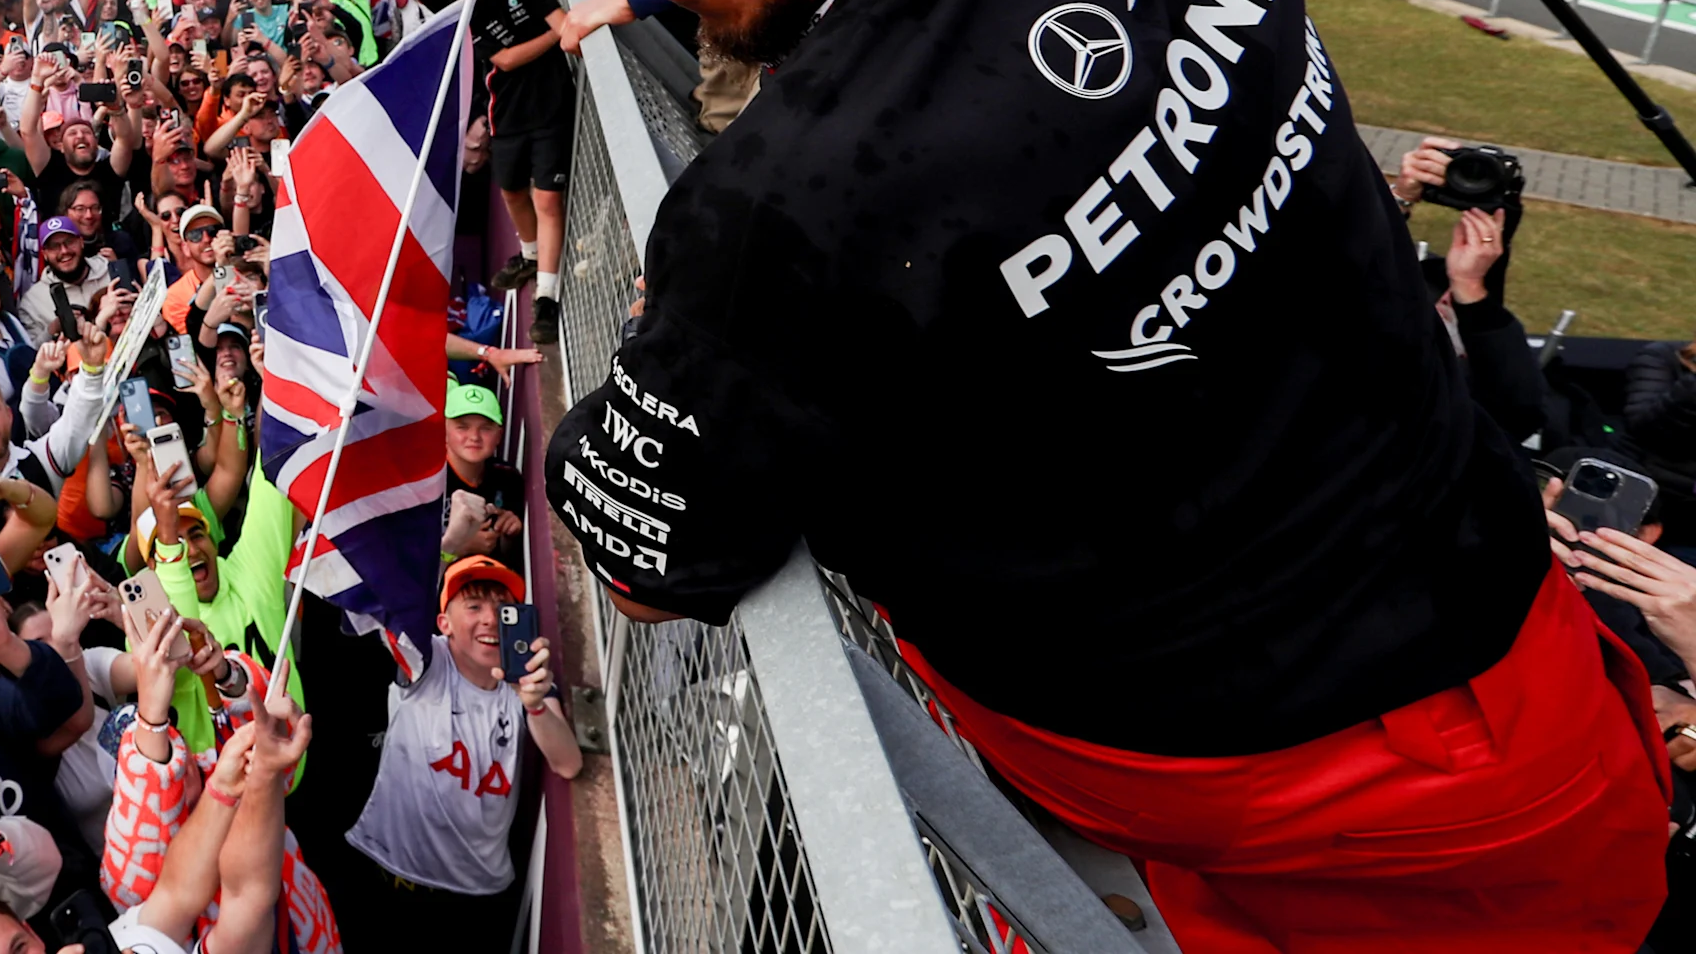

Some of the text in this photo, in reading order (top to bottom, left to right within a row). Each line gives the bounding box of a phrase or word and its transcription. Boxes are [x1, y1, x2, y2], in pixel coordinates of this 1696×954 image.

[602, 400, 663, 468] IWC
[613, 363, 700, 437] SOLERA
[562, 499, 631, 558] AMD
[563, 460, 671, 544] PIRELLI
[429, 740, 512, 798] AA
